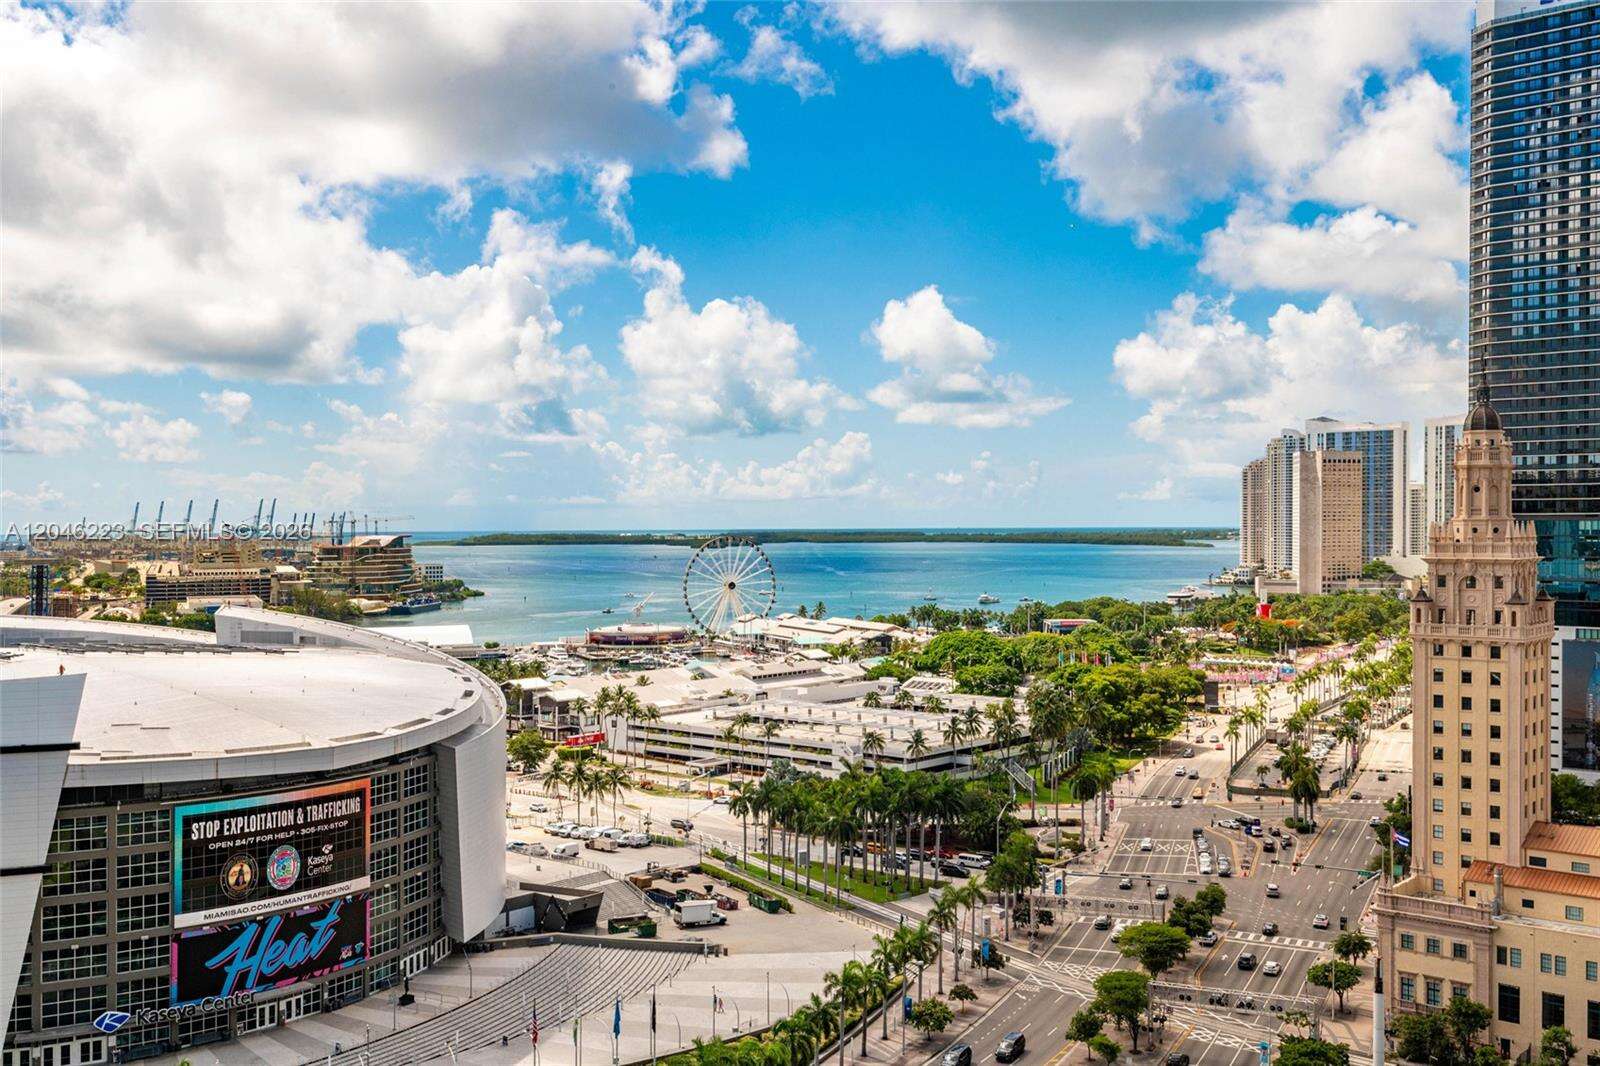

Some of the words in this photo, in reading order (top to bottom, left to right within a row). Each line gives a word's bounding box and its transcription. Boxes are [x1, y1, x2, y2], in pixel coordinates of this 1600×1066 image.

[191, 820, 221, 841] STOP
[223, 808, 295, 836] EXPLOITATION
[296, 807, 304, 825] &
[306, 796, 361, 823] TRAFFICKING
[208, 841, 234, 850] OPEN
[235, 837, 254, 846] 24/7
[255, 834, 274, 843] FOR
[274, 830, 296, 840] HELP
[307, 852, 334, 866] Kaseya
[307, 863, 333, 876] Center
[205, 899, 345, 999] Heat
[135, 1003, 196, 1026] Kaseya
[200, 989, 257, 1013] Center
